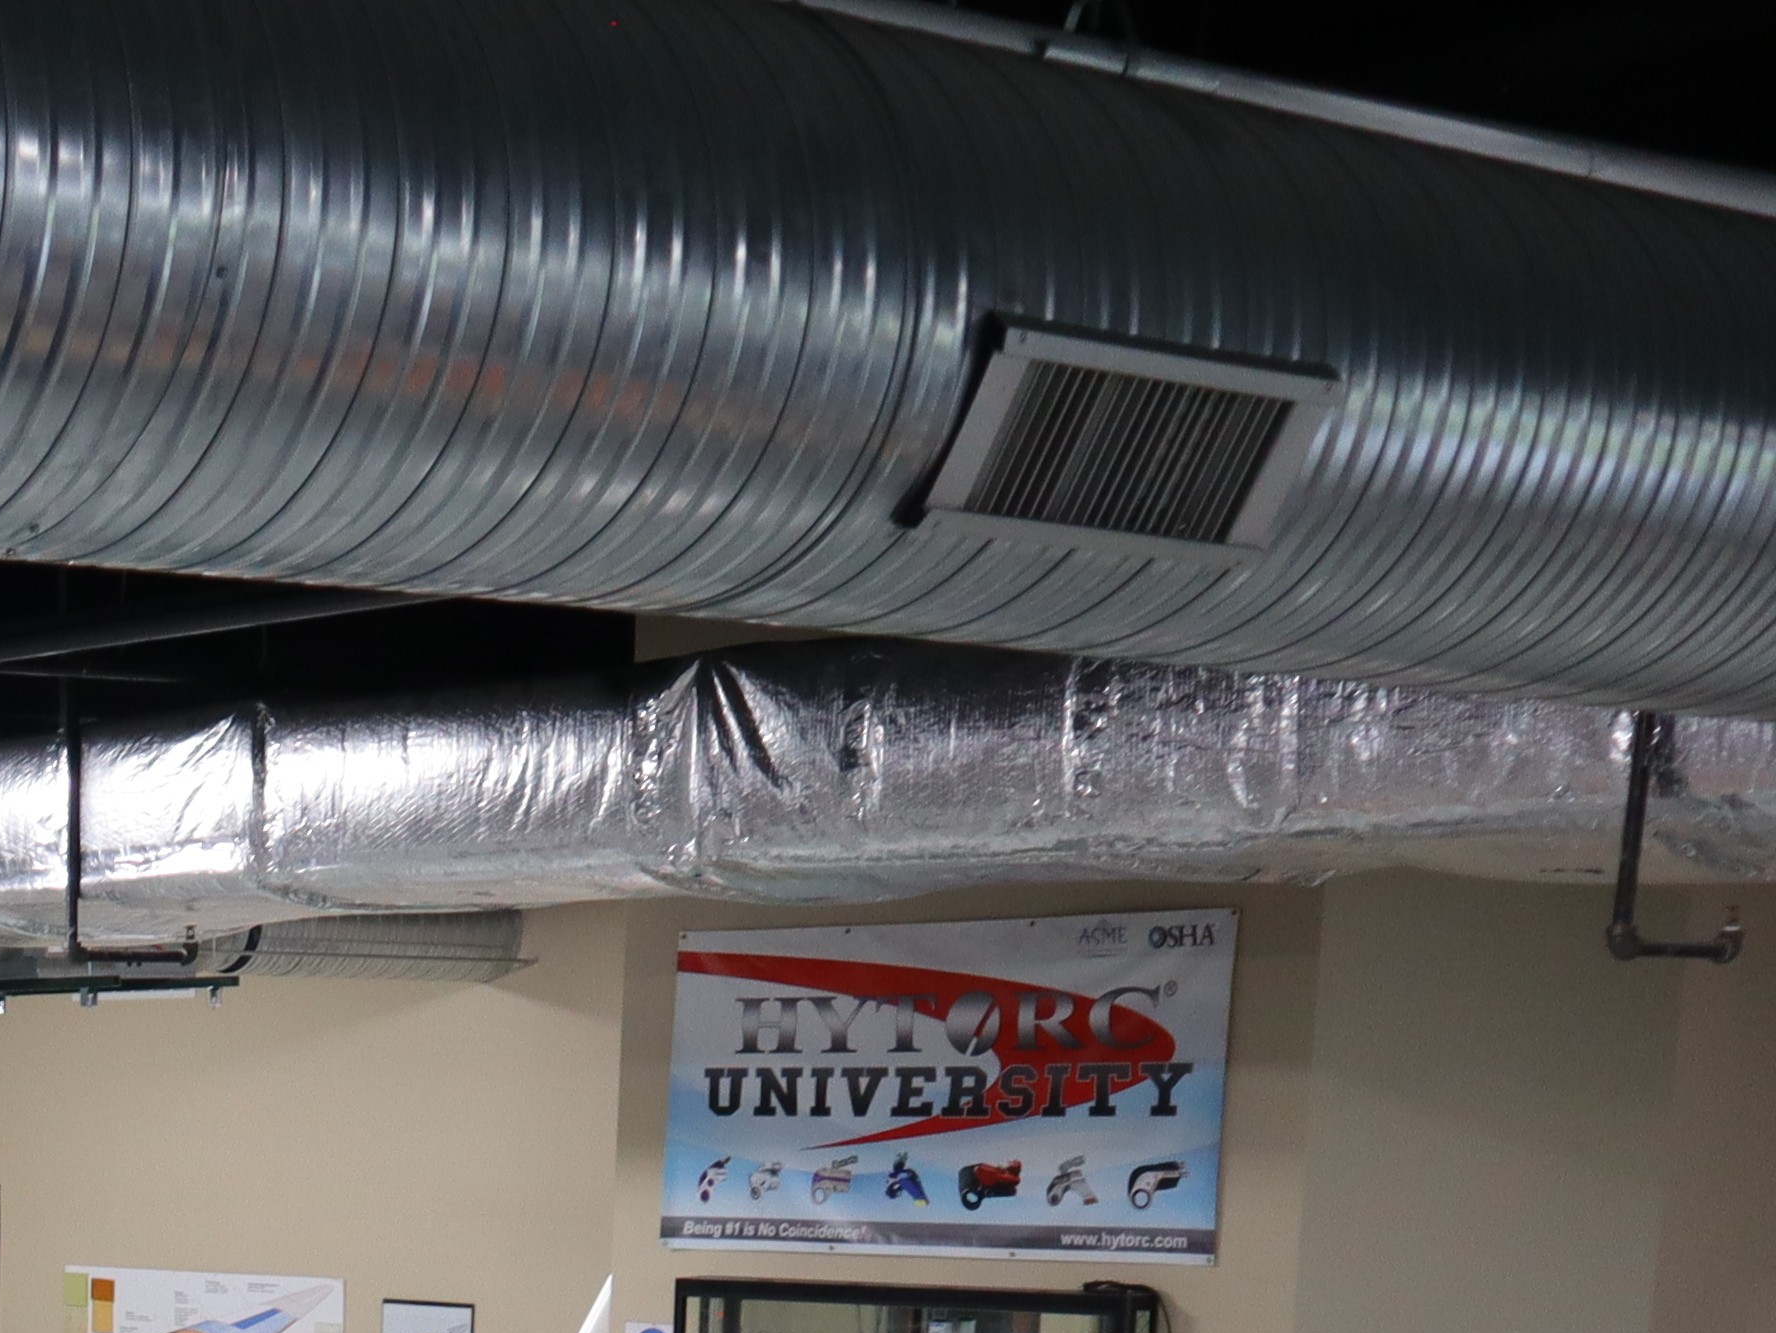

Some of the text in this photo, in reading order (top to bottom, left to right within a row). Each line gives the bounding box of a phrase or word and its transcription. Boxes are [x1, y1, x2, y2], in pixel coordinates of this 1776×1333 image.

[1077, 926, 1128, 945] ASME
[1148, 923, 1216, 949] OSHA
[734, 986, 1161, 1057] HYTORC
[704, 1062, 1194, 1118] UNIVERSITY
[682, 1220, 869, 1241] Being #1 is No Coincidence!
[1060, 1231, 1188, 1250] www.hytorc.com
